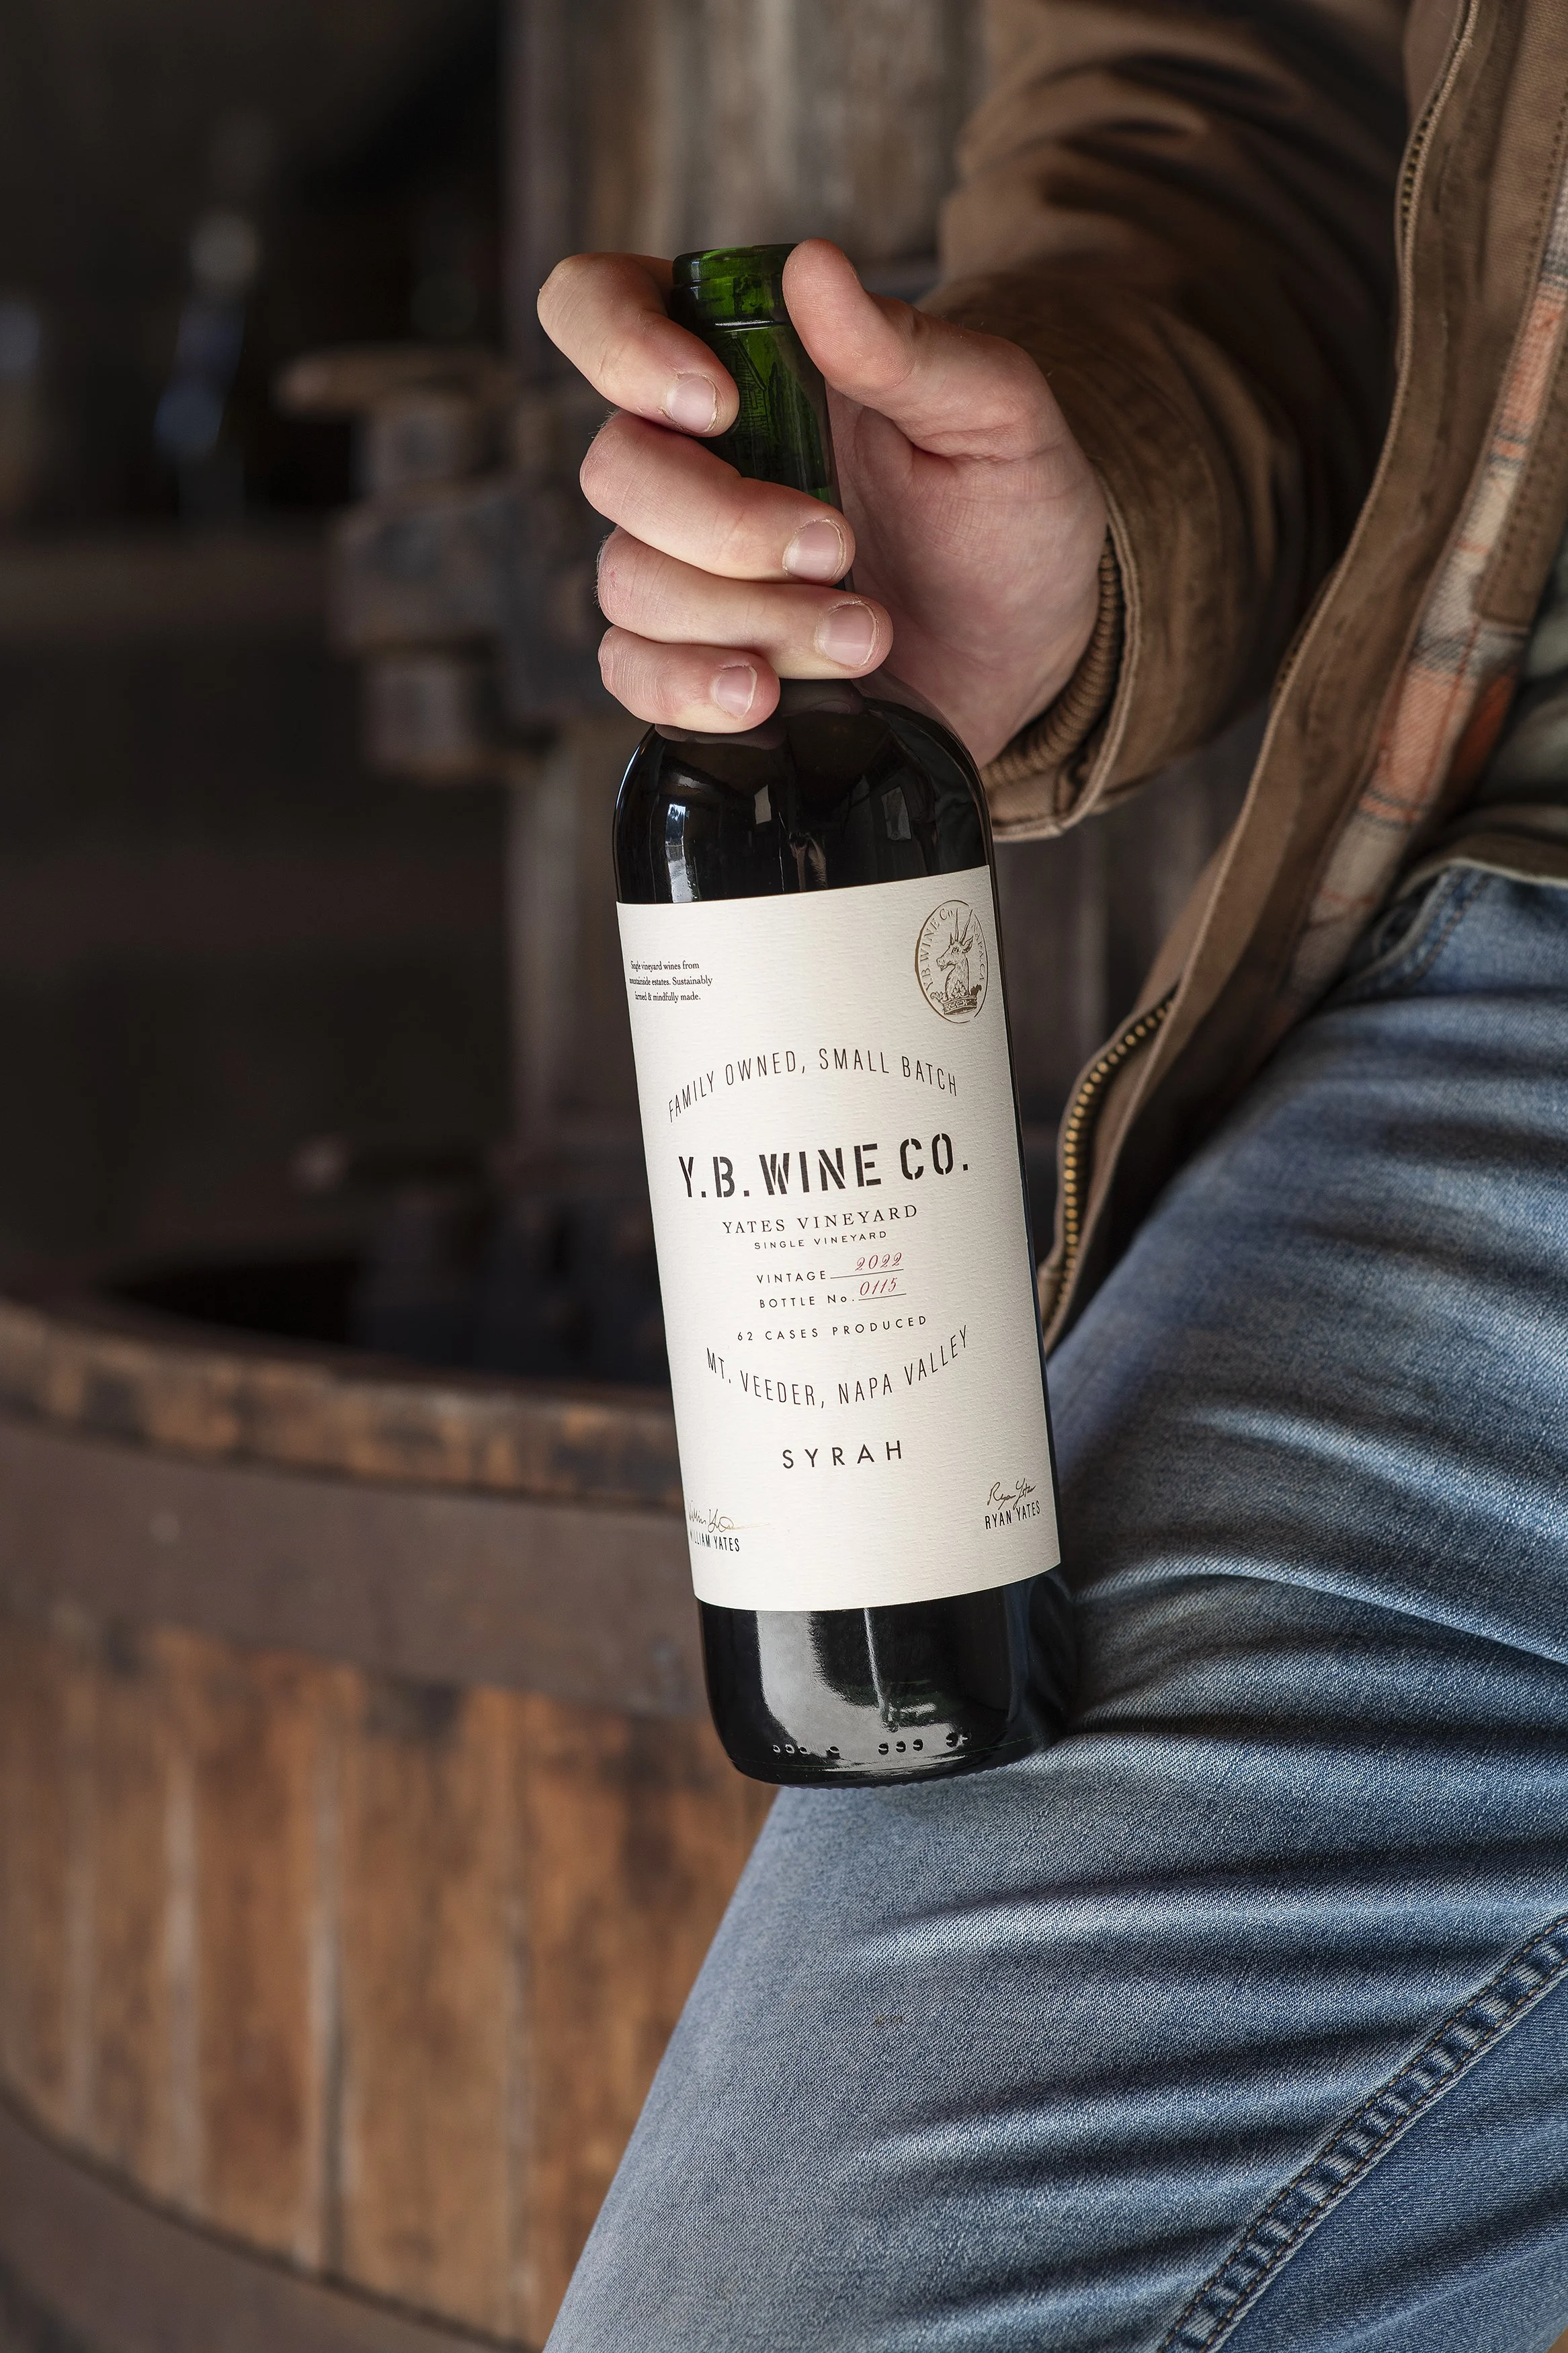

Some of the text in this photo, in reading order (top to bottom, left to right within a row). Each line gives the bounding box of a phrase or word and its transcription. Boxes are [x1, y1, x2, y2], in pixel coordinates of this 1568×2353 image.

[641, 961, 663, 972] vineyard
[663, 961, 681, 970] wines
[682, 960, 700, 970] from
[651, 978, 671, 986] estates.
[672, 975, 713, 987] Sustainably
[647, 992, 652, 1000] &
[653, 992, 679, 1004] mindfully
[681, 991, 701, 1001] made.
[669, 1047, 958, 1123] FAMILY OWNED, SMALL BATCH
[678, 1132, 969, 1199] Y.B. WINE CO.
[722, 1204, 918, 1235] YATES VINEYARD
[754, 1230, 887, 1250] SINGLE VINEYARD
[756, 1252, 903, 1285] VINTAGE 2022
[759, 1277, 899, 1308] BOTTLE No. 0115
[737, 1316, 927, 1342] 62 CASES PRODUCED
[706, 1324, 967, 1410] MT. VEEDER, NAPA VALLEY
[782, 1439, 903, 1470] SYRAH
[985, 1500, 1040, 1530] RYAN YATES
[713, 1535, 740, 1552] YATES
